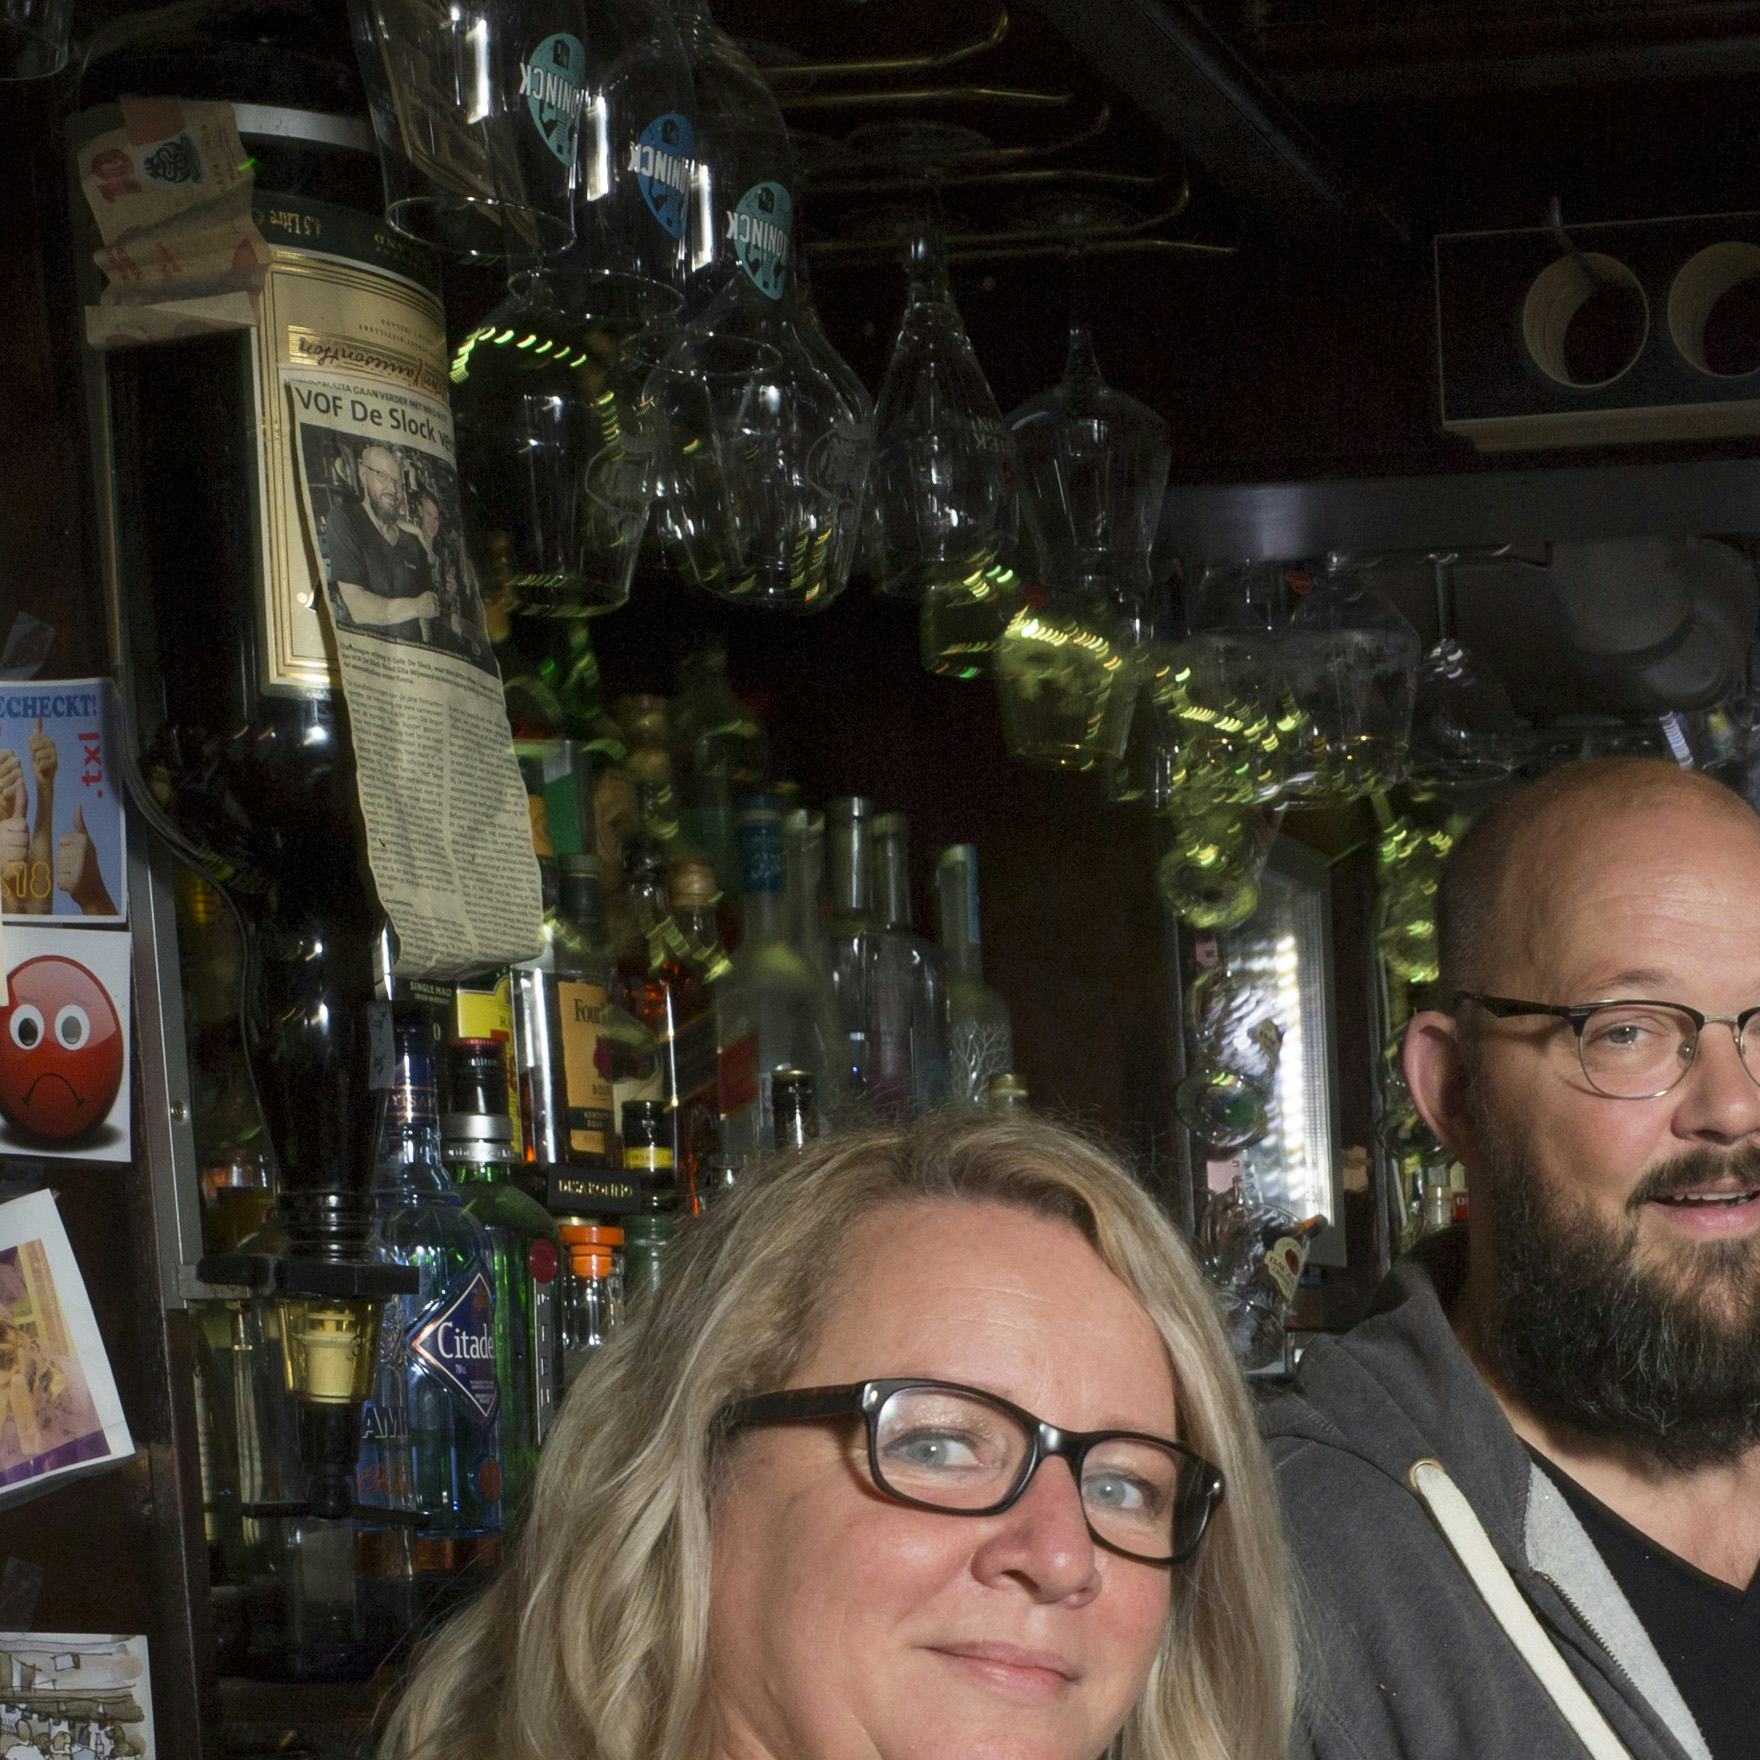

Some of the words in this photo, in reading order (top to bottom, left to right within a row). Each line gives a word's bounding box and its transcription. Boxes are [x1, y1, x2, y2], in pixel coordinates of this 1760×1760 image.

[295, 387, 343, 417] VOF
[351, 400, 383, 427] De
[389, 408, 436, 443] Slock
[437, 1321, 495, 1360] Citade
